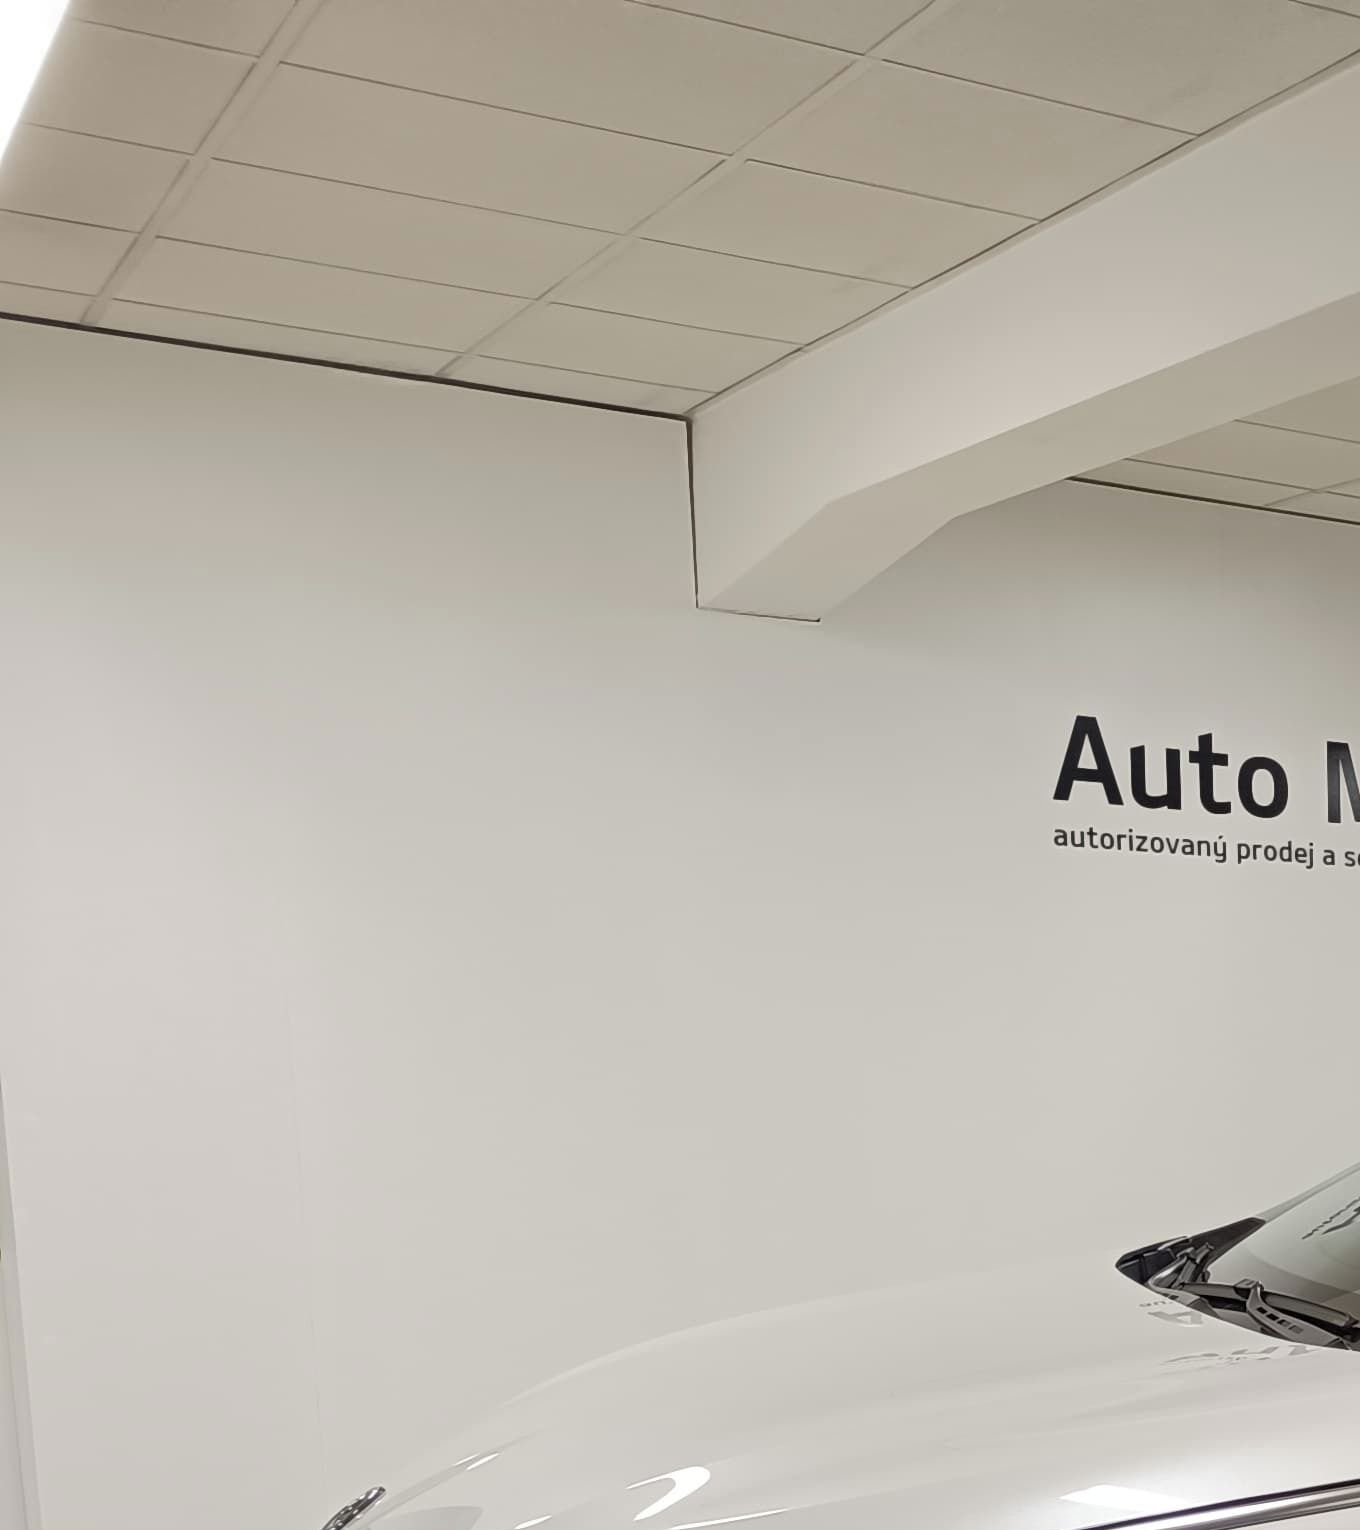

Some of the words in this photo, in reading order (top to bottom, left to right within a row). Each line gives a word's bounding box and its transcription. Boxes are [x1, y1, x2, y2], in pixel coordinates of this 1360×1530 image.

[1052, 714, 1289, 819] Auto
[1053, 826, 1227, 864] autorizovaný
[1237, 840, 1314, 870] prodej
[1322, 849, 1336, 866] a
